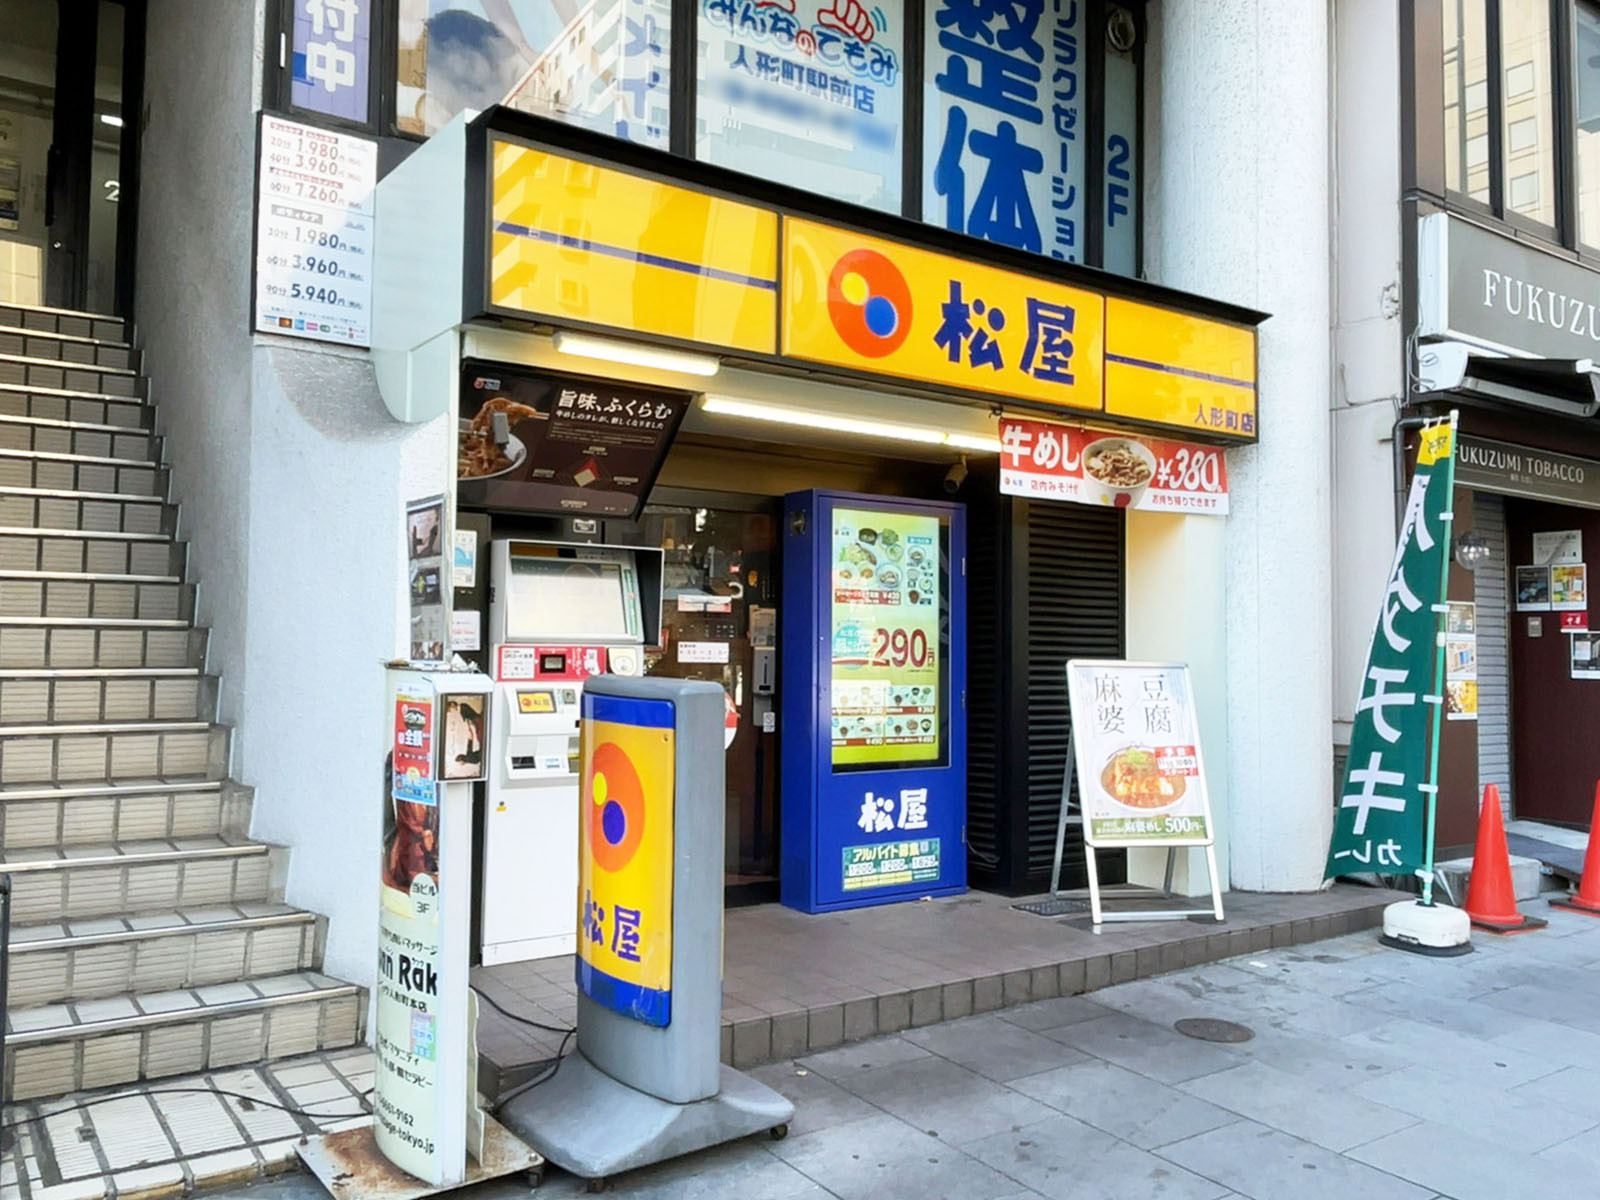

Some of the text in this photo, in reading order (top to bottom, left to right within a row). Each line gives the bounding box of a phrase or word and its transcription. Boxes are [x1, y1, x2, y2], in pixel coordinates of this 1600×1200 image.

[1107, 134, 1130, 227] 2F
[933, 279, 1076, 386] 松屋
[1193, 402, 1255, 434] 人形町店
[1002, 424, 1081, 472] 牛めし
[1526, 456, 1584, 484] TOBACCO
[857, 788, 929, 833] 松屋
[417, 901, 430, 914] 3F
[582, 888, 642, 962] 松屋
[400, 954, 438, 996] Rak
